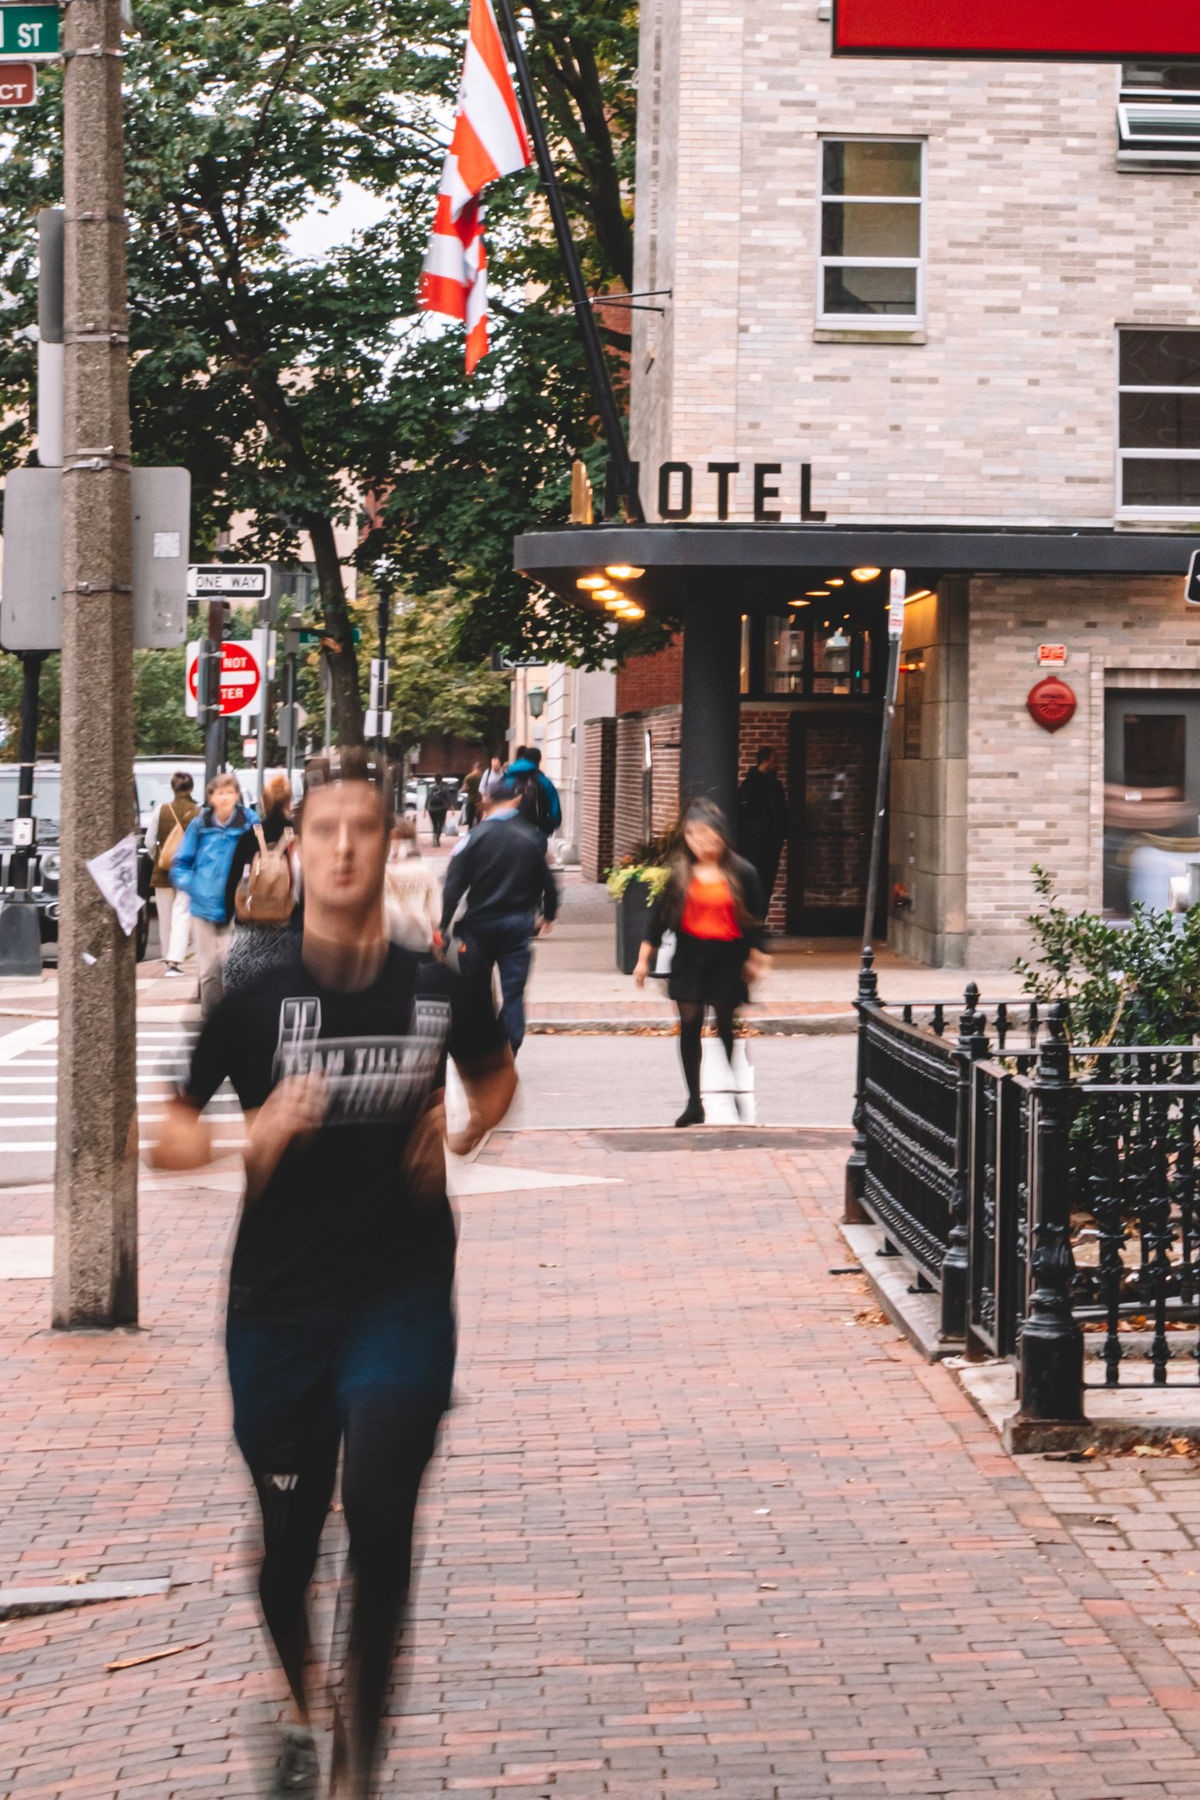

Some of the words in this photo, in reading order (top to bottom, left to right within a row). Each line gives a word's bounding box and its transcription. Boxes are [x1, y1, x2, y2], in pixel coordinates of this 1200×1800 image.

[17, 23, 43, 48] ST
[195, 576, 222, 588] ONE
[231, 576, 259, 588] WAY
[223, 657, 248, 669] NOT
[221, 688, 244, 699] TER
